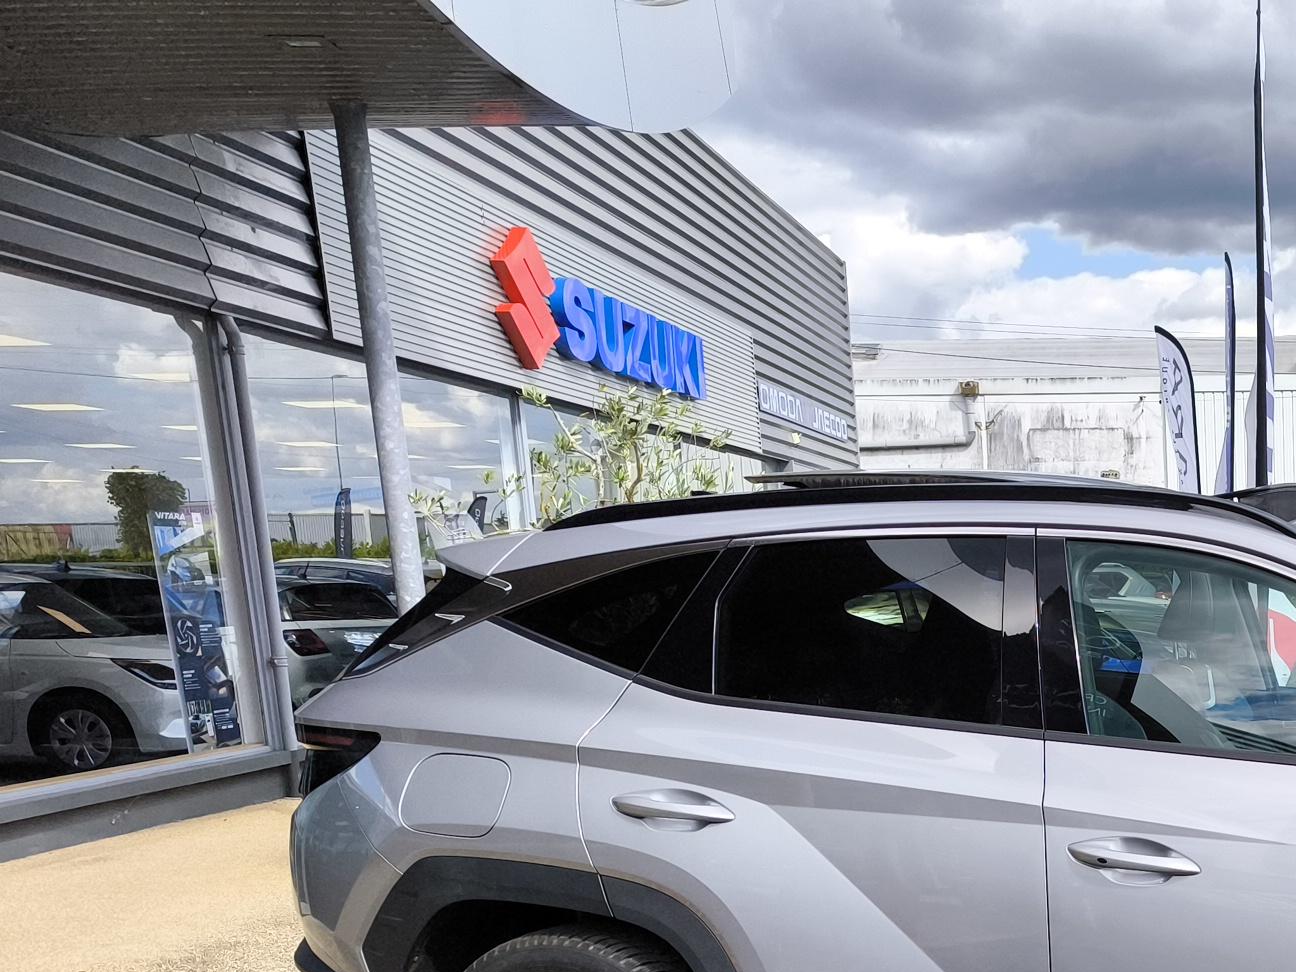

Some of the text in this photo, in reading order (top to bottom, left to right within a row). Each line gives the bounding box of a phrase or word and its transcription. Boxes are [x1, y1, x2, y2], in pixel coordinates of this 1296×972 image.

[555, 277, 707, 399] SUZUKI
[760, 384, 803, 422] OMODA
[155, 511, 186, 521] VITARA
